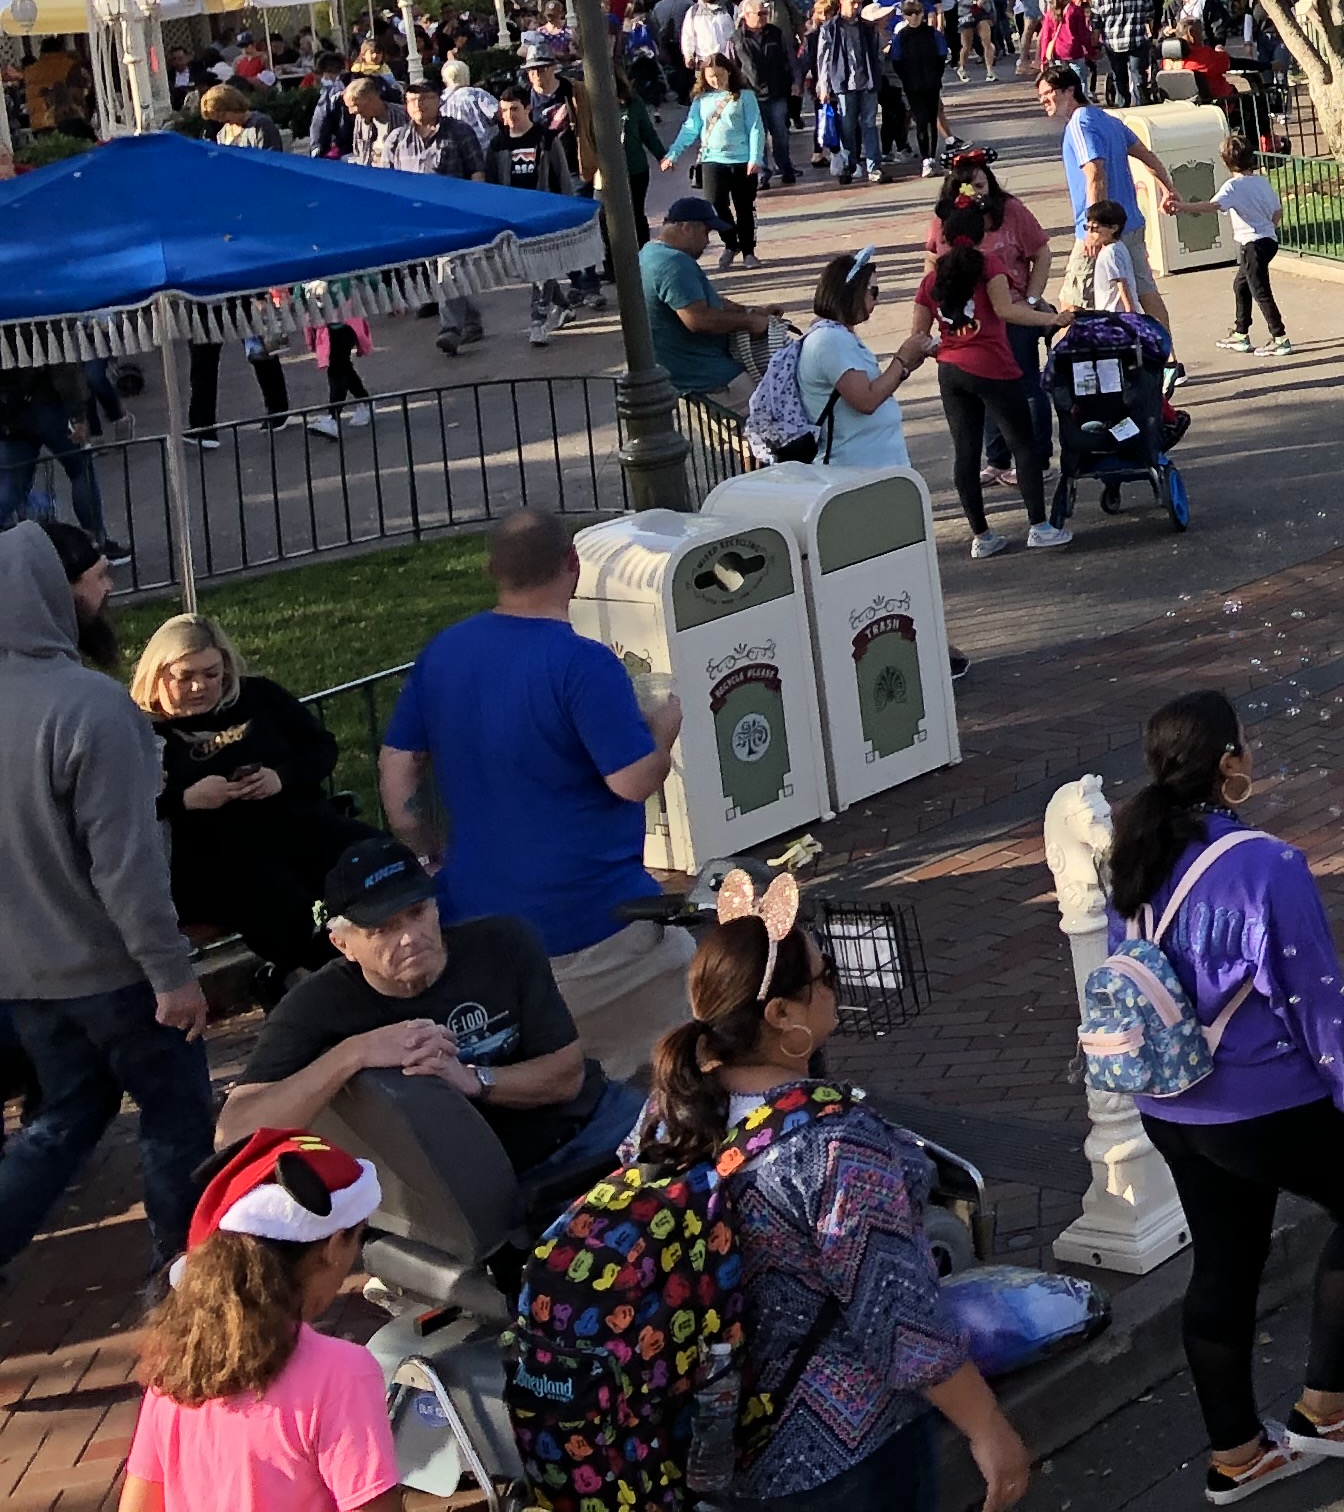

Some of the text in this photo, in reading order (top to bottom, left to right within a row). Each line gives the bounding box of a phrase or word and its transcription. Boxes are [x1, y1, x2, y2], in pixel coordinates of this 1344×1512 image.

[864, 618, 900, 639] TRASH
[714, 668, 775, 699] RECYCLE PLEASE
